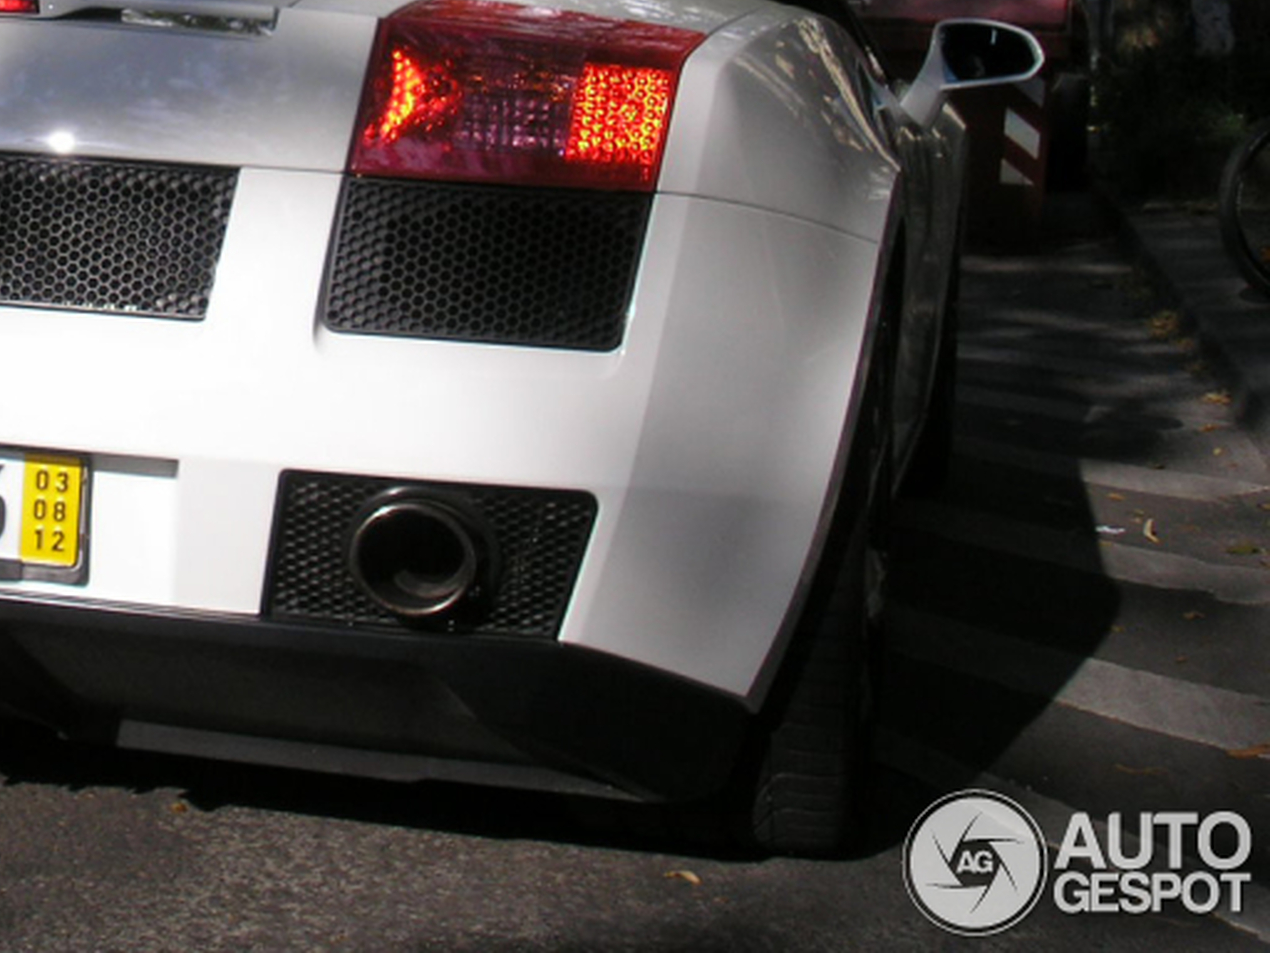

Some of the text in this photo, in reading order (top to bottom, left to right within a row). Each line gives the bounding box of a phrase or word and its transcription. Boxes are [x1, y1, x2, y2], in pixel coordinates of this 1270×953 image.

[35, 469, 70, 493] 03
[33, 493, 67, 521] 08
[33, 528, 66, 553] 12
